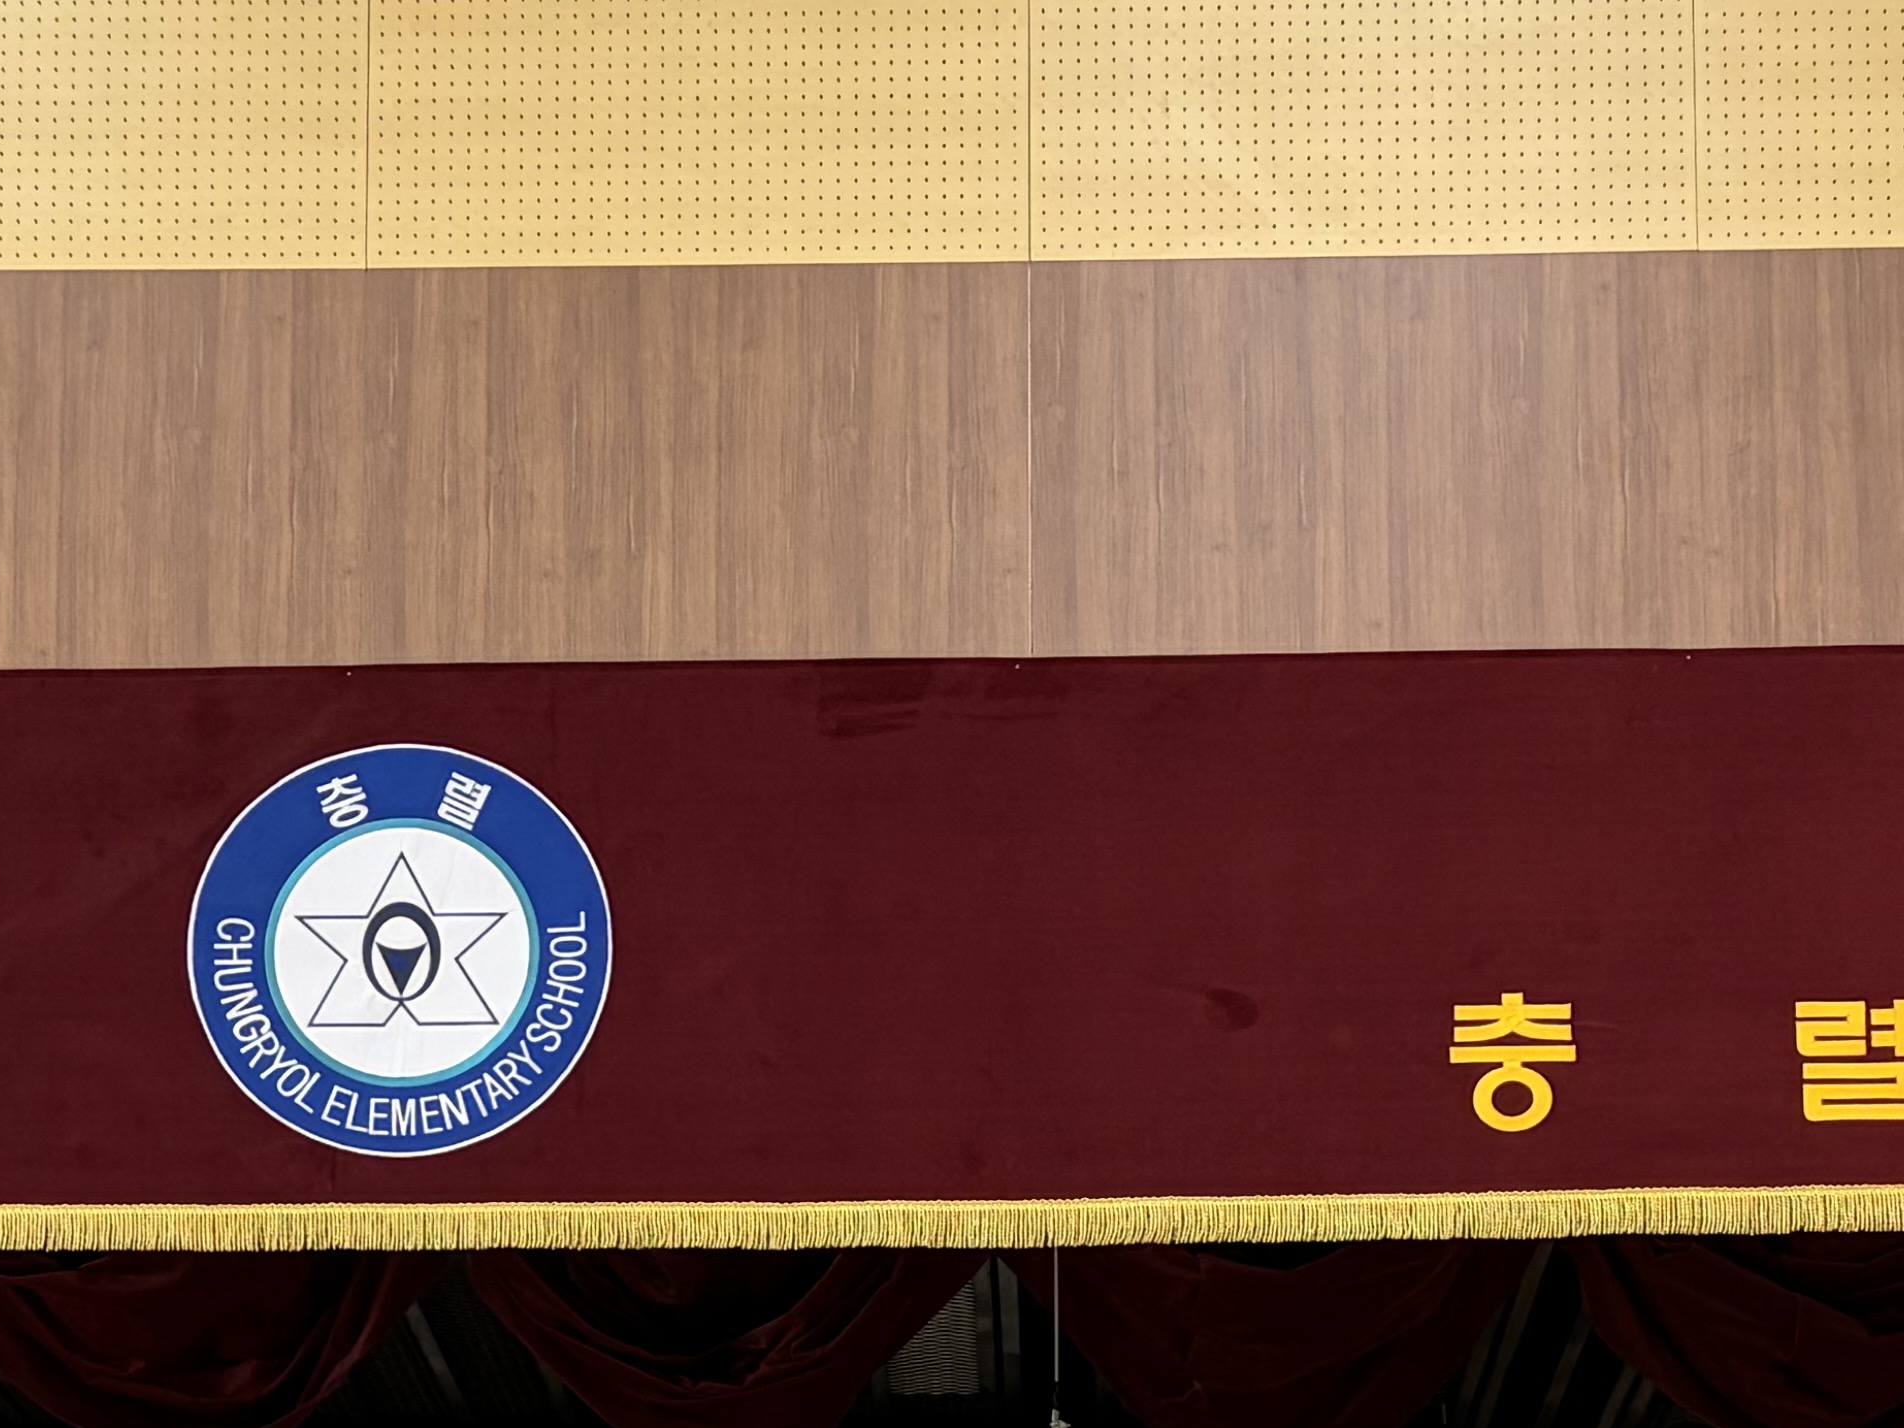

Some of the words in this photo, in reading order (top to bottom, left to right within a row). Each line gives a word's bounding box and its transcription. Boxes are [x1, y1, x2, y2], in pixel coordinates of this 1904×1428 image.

[213, 916, 320, 1114] CHUNGRYOL
[320, 1040, 542, 1137] ELEMENTARY
[526, 910, 588, 1053] SCHOOL
